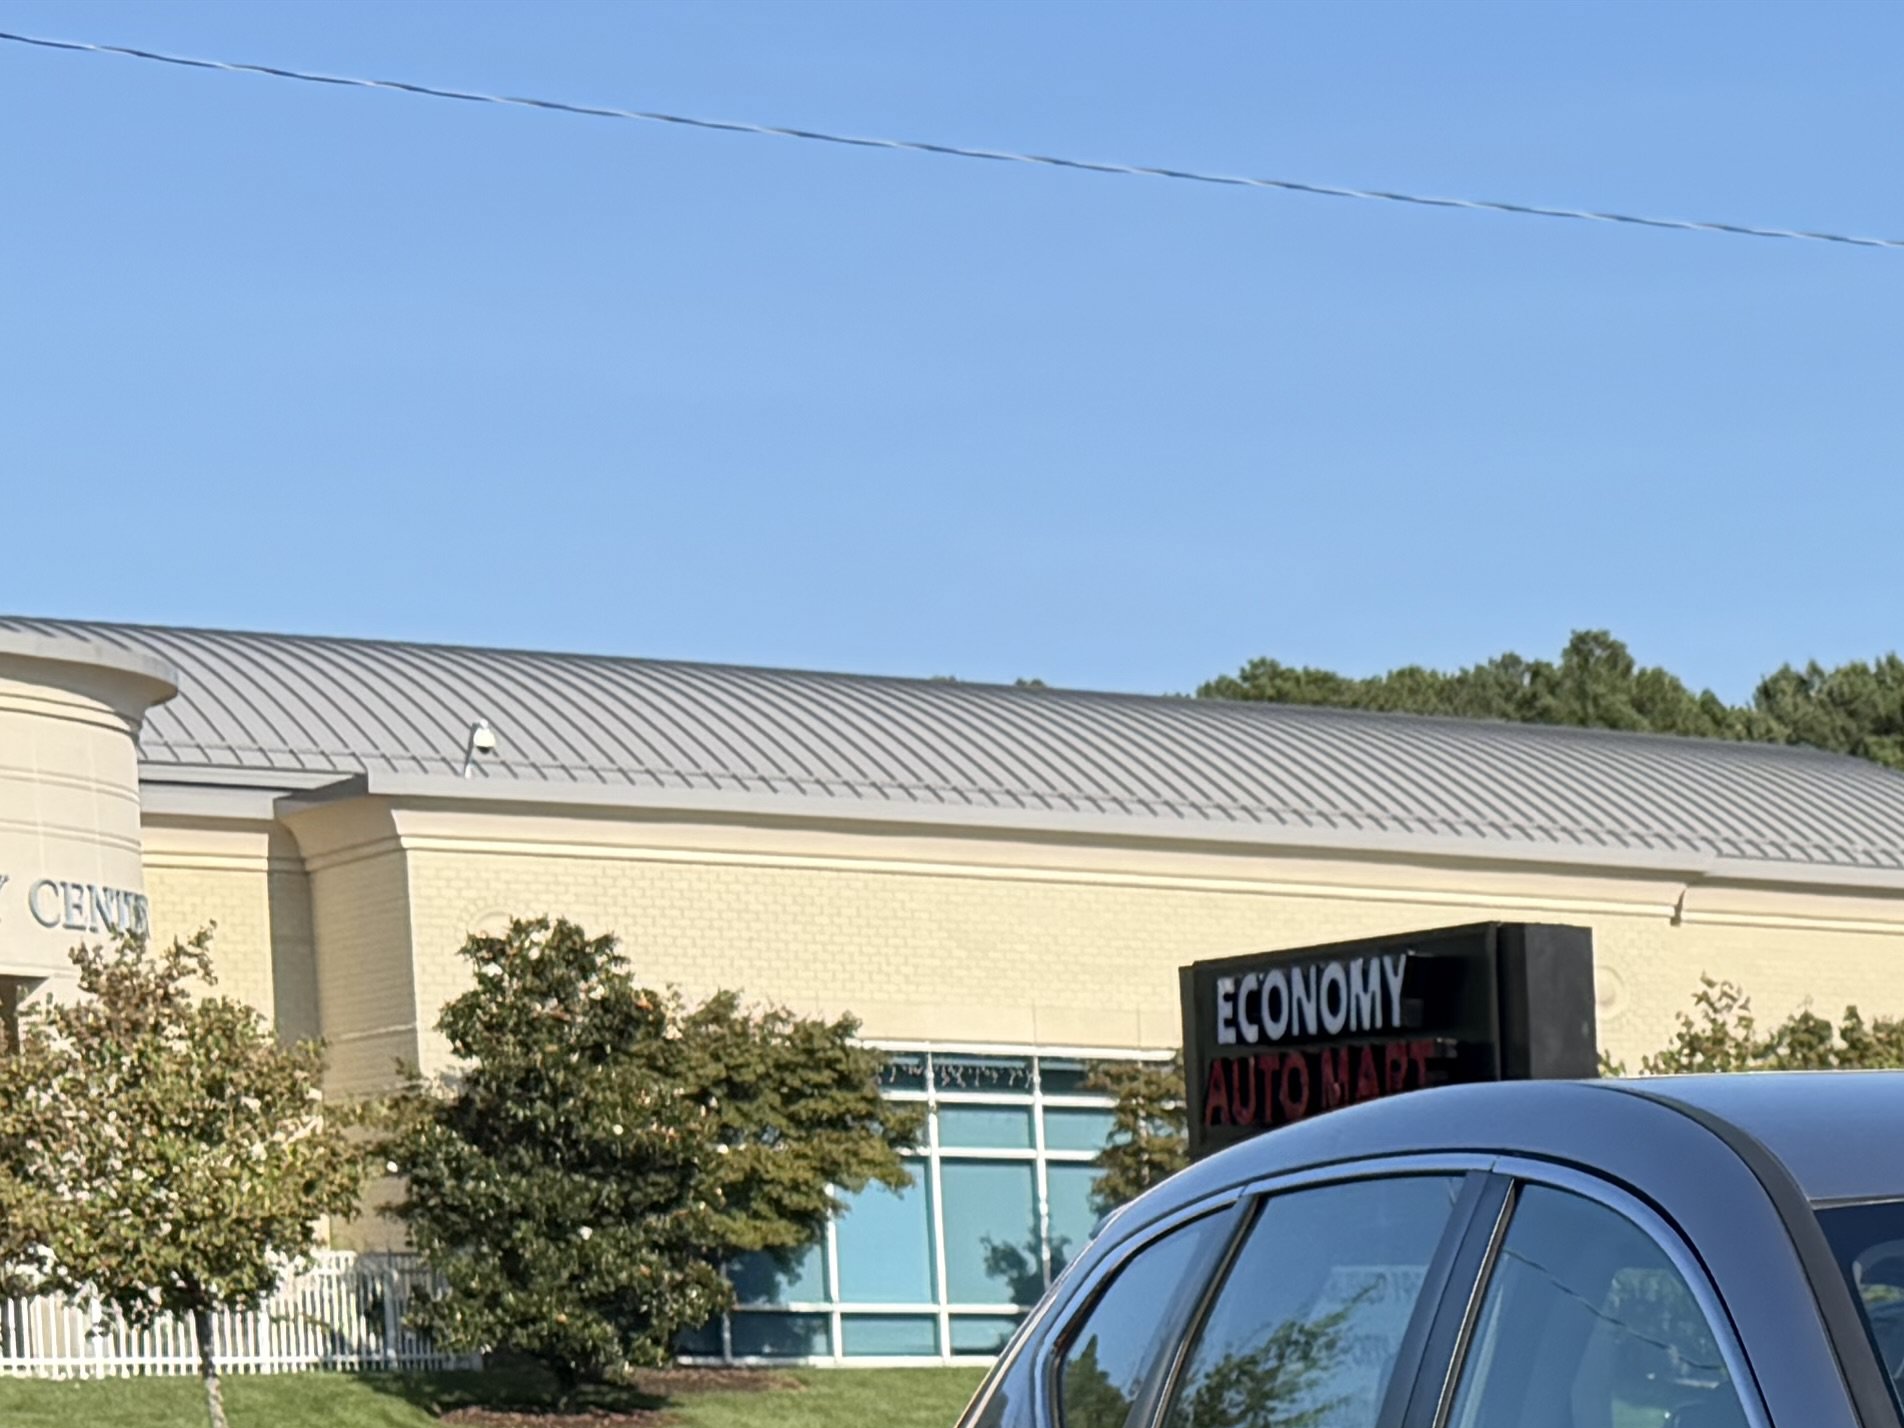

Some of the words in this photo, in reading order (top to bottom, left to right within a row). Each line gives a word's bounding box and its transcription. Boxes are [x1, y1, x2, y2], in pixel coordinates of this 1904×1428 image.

[1217, 953, 1406, 1045] ECONOMY
[1205, 1050, 1309, 1127] AUTO
[1322, 1039, 1434, 1106] MART
